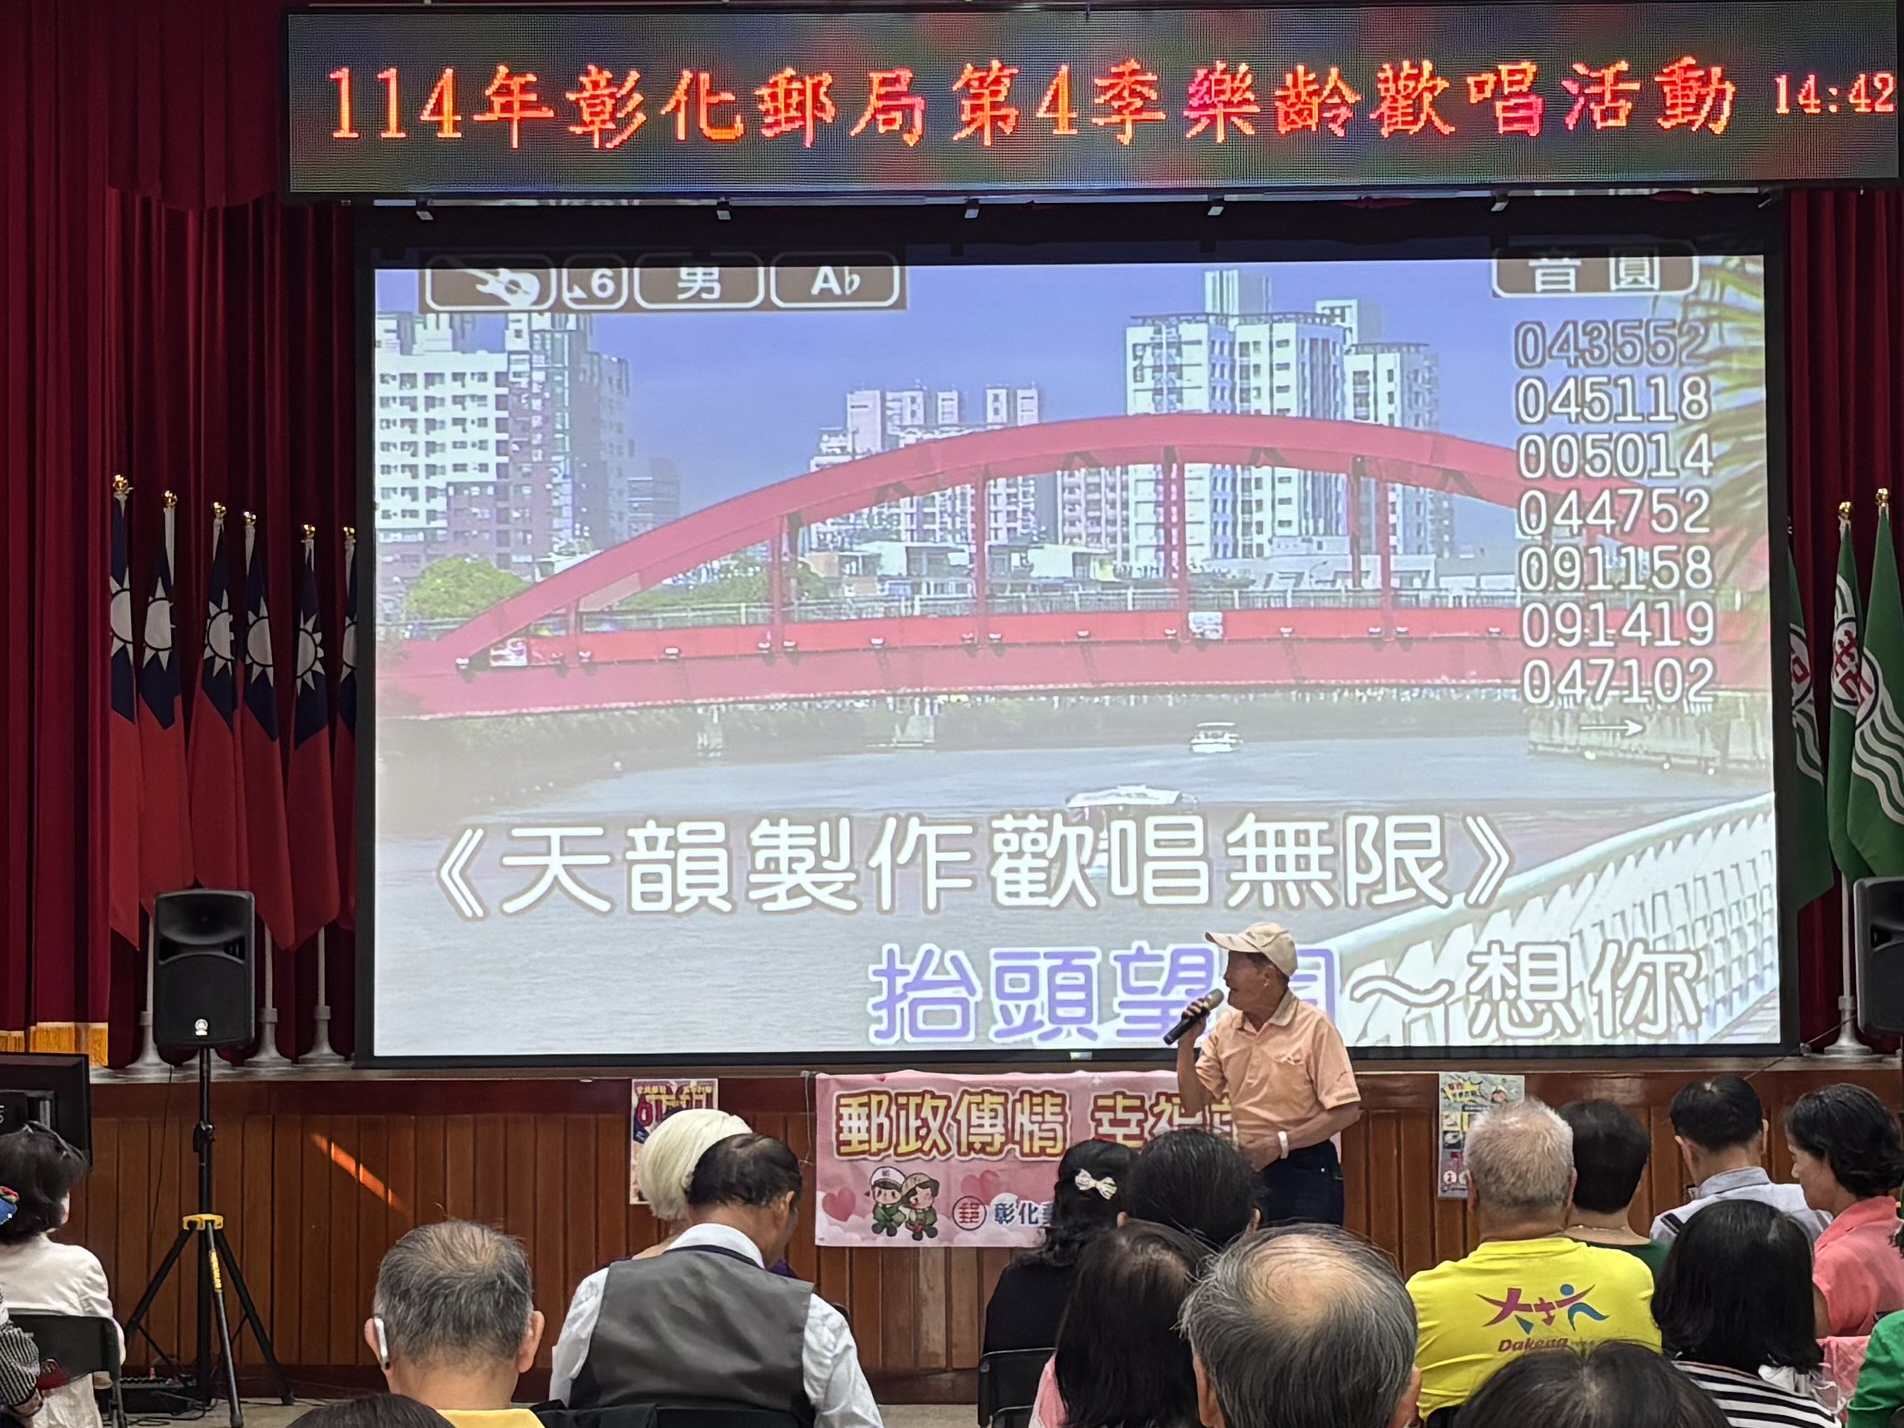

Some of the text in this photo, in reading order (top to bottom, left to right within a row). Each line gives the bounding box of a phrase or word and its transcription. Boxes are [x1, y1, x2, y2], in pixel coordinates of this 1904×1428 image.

[329, 58, 1895, 149] 114年彰化郵局第4季樂齡歡唱活動 14:42
[676, 267, 722, 301] 男
[1515, 320, 1709, 368] 043552
[1517, 376, 1710, 422] 045118
[1519, 433, 1713, 478] 005014
[1520, 489, 1711, 534] 044752
[1521, 545, 1713, 591] 091158
[1522, 601, 1715, 648] 091419
[1523, 658, 1715, 705] 047102
[438, 812, 1511, 919] 《天韻製作歡唱無限》
[833, 1088, 1070, 1161] 郵政傳情
